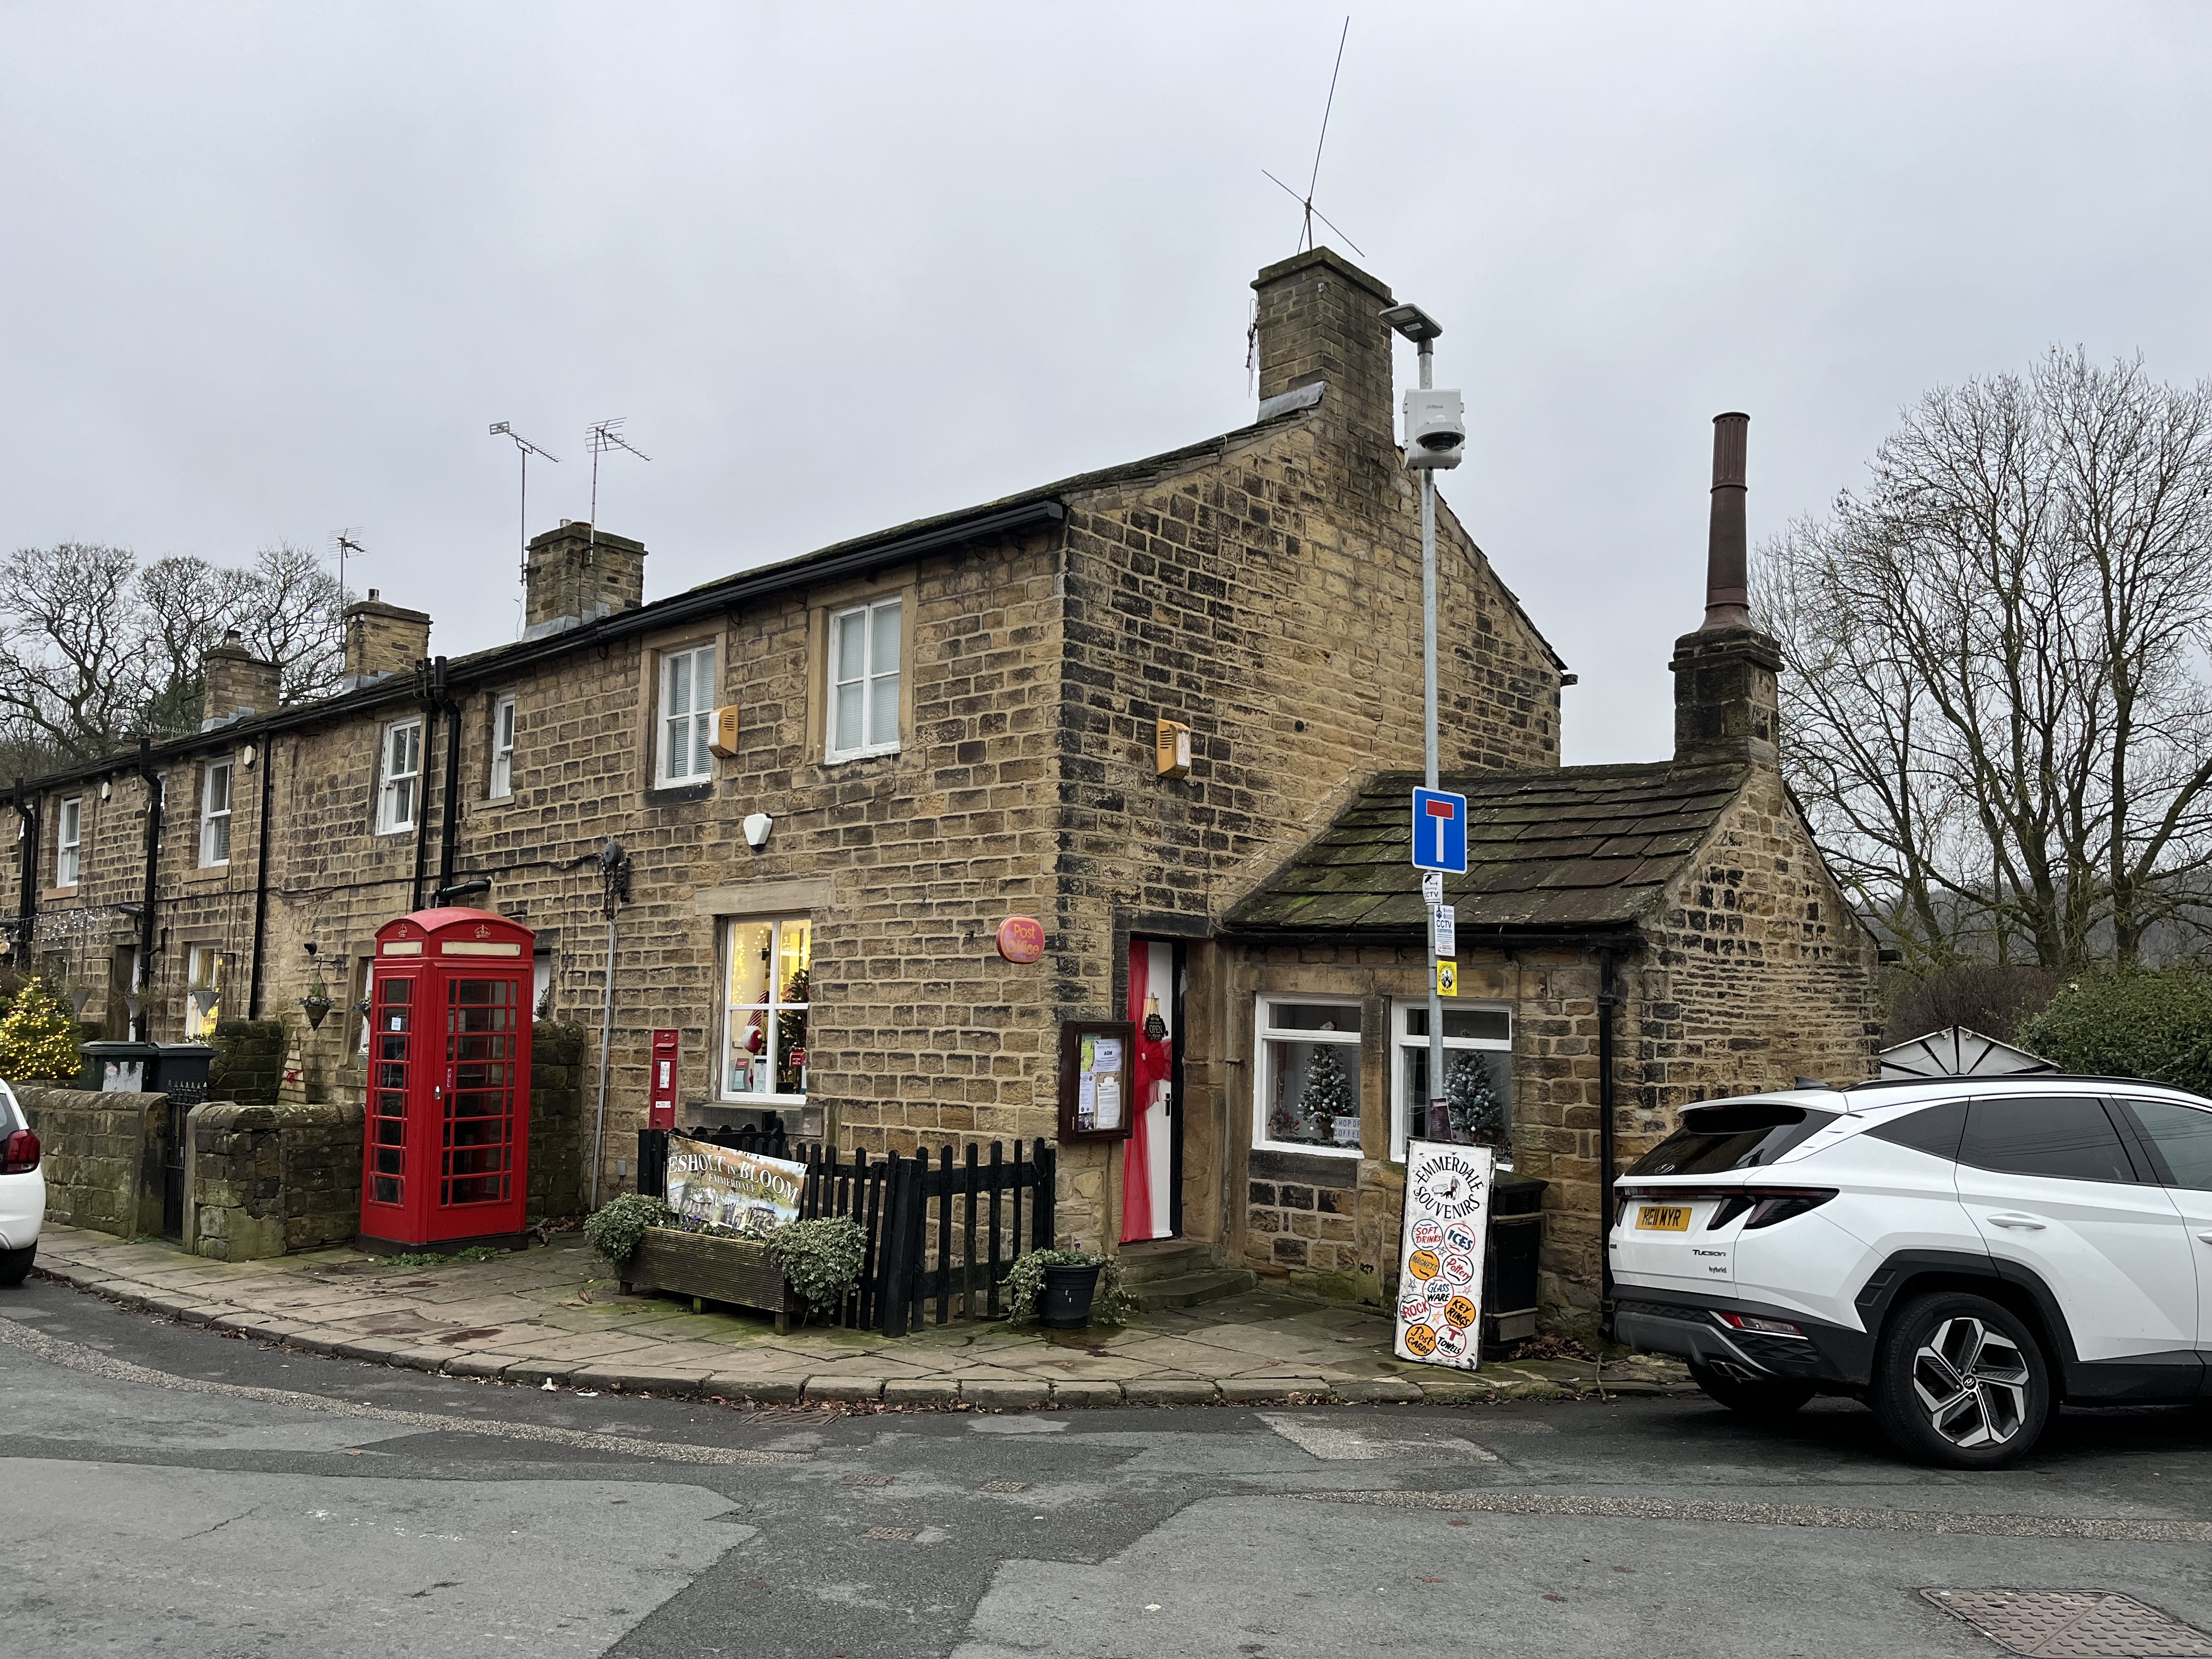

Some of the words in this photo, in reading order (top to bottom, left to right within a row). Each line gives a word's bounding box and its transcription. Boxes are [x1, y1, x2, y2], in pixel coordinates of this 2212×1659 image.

[1014, 923, 1036, 939] Post
[1436, 919, 1452, 928] CCTV
[1007, 939, 1040, 956] Office
[1149, 1024, 1163, 1034] OPEN
[1334, 1130, 1359, 1138] COFFEE
[668, 1154, 726, 1173] ESHOLT
[727, 1165, 735, 1176] IN
[740, 1161, 799, 1205] BLOOM
[1415, 1156, 1484, 1192] EMMERDALE
[708, 1173, 757, 1194] EMMERDALE
[1413, 1186, 1480, 1219] SOUVENIRS
[1660, 1209, 1681, 1227] MYR
[1415, 1227, 1438, 1235] SOFT
[1415, 1234, 1441, 1243] DRINKS
[1448, 1229, 1473, 1250] ICES
[1411, 1255, 1438, 1272] MAGNETS
[1446, 1258, 1471, 1281] Pottery
[1427, 1282, 1449, 1293] GLASS
[1427, 1293, 1450, 1302] WARE
[1452, 1299, 1472, 1313] KEY
[1402, 1300, 1429, 1318] ROCK
[1447, 1307, 1470, 1326] RINGS
[1411, 1326, 1434, 1346] Post
[1408, 1337, 1430, 1354] CARDS
[1437, 1336, 1462, 1354] TOWELS
